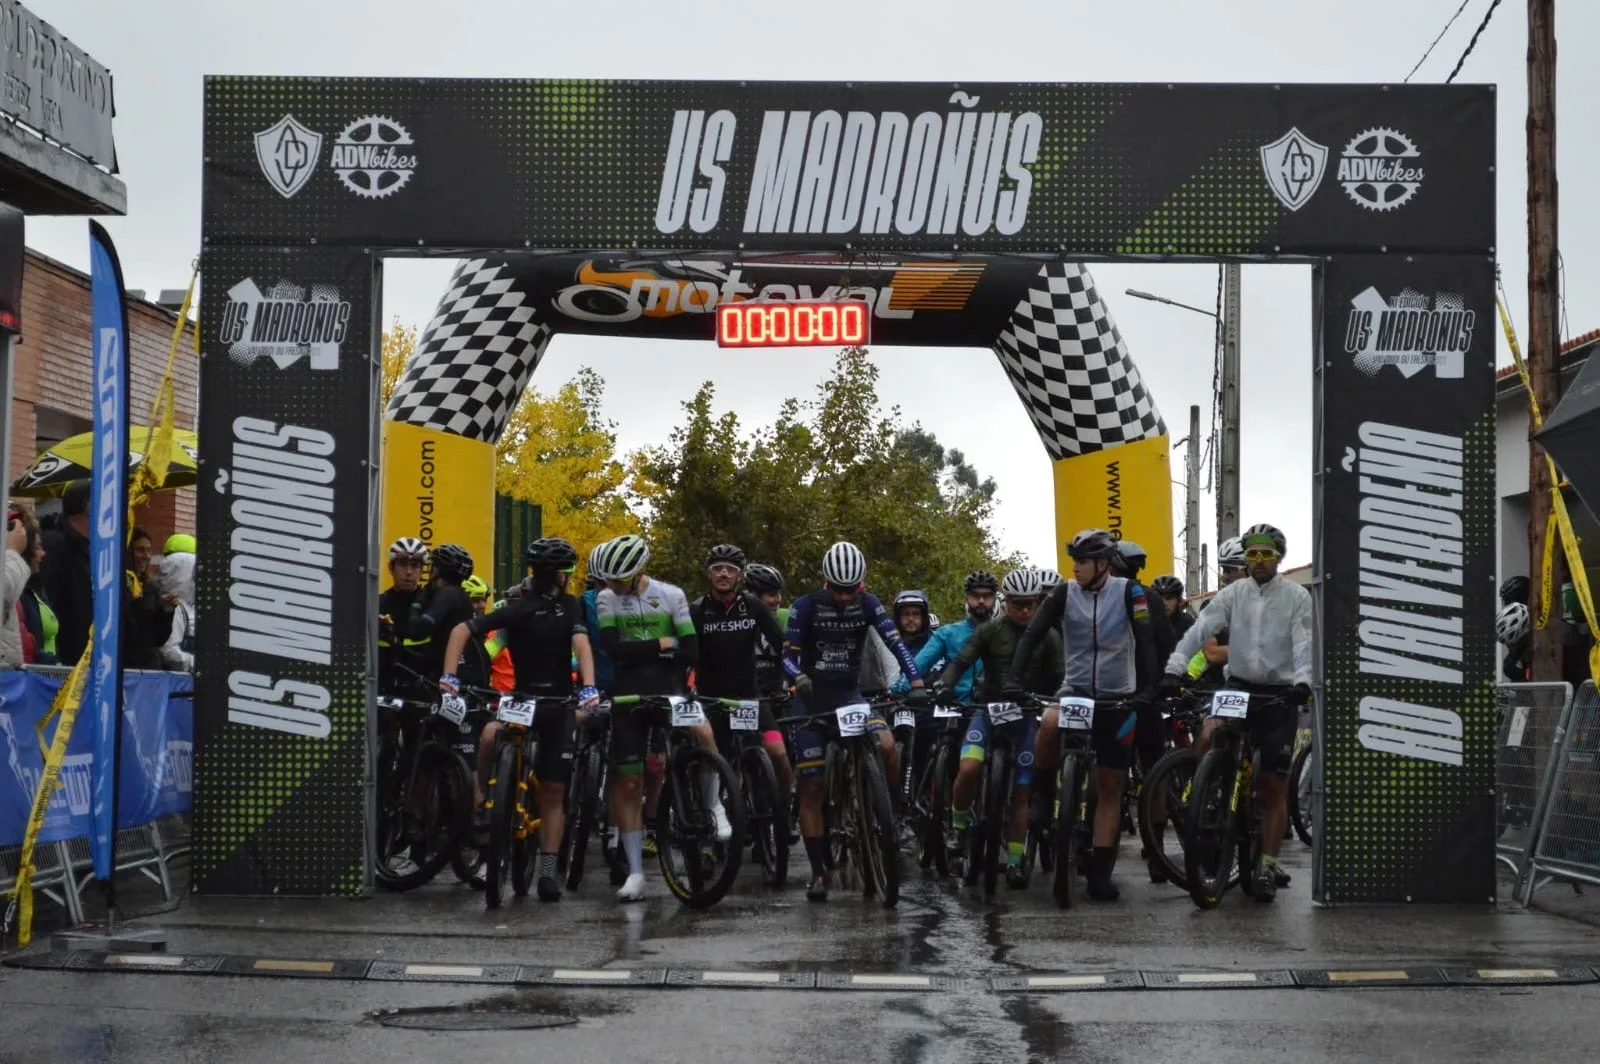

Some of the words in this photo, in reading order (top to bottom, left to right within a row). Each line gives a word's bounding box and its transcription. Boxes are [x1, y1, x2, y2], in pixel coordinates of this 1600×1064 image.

[331, 145, 418, 168] ADVbikes
[655, 110, 736, 233] US
[743, 91, 1042, 236] MADROÑUS
[1337, 158, 1425, 181] ADVbikes
[220, 300, 249, 343] US
[250, 295, 351, 344] MADROÑUS
[722, 306, 863, 343] 00:00:00
[1345, 309, 1373, 352] US
[1375, 303, 1475, 352] MADROÑUS
[1105, 460, 1123, 541] www.ne
[214, 415, 336, 666] MADROÑUS
[1342, 420, 1463, 684] VALVERDEÑA
[228, 669, 332, 738] US
[844, 713, 866, 725] 152
[1358, 695, 1463, 766] AD
